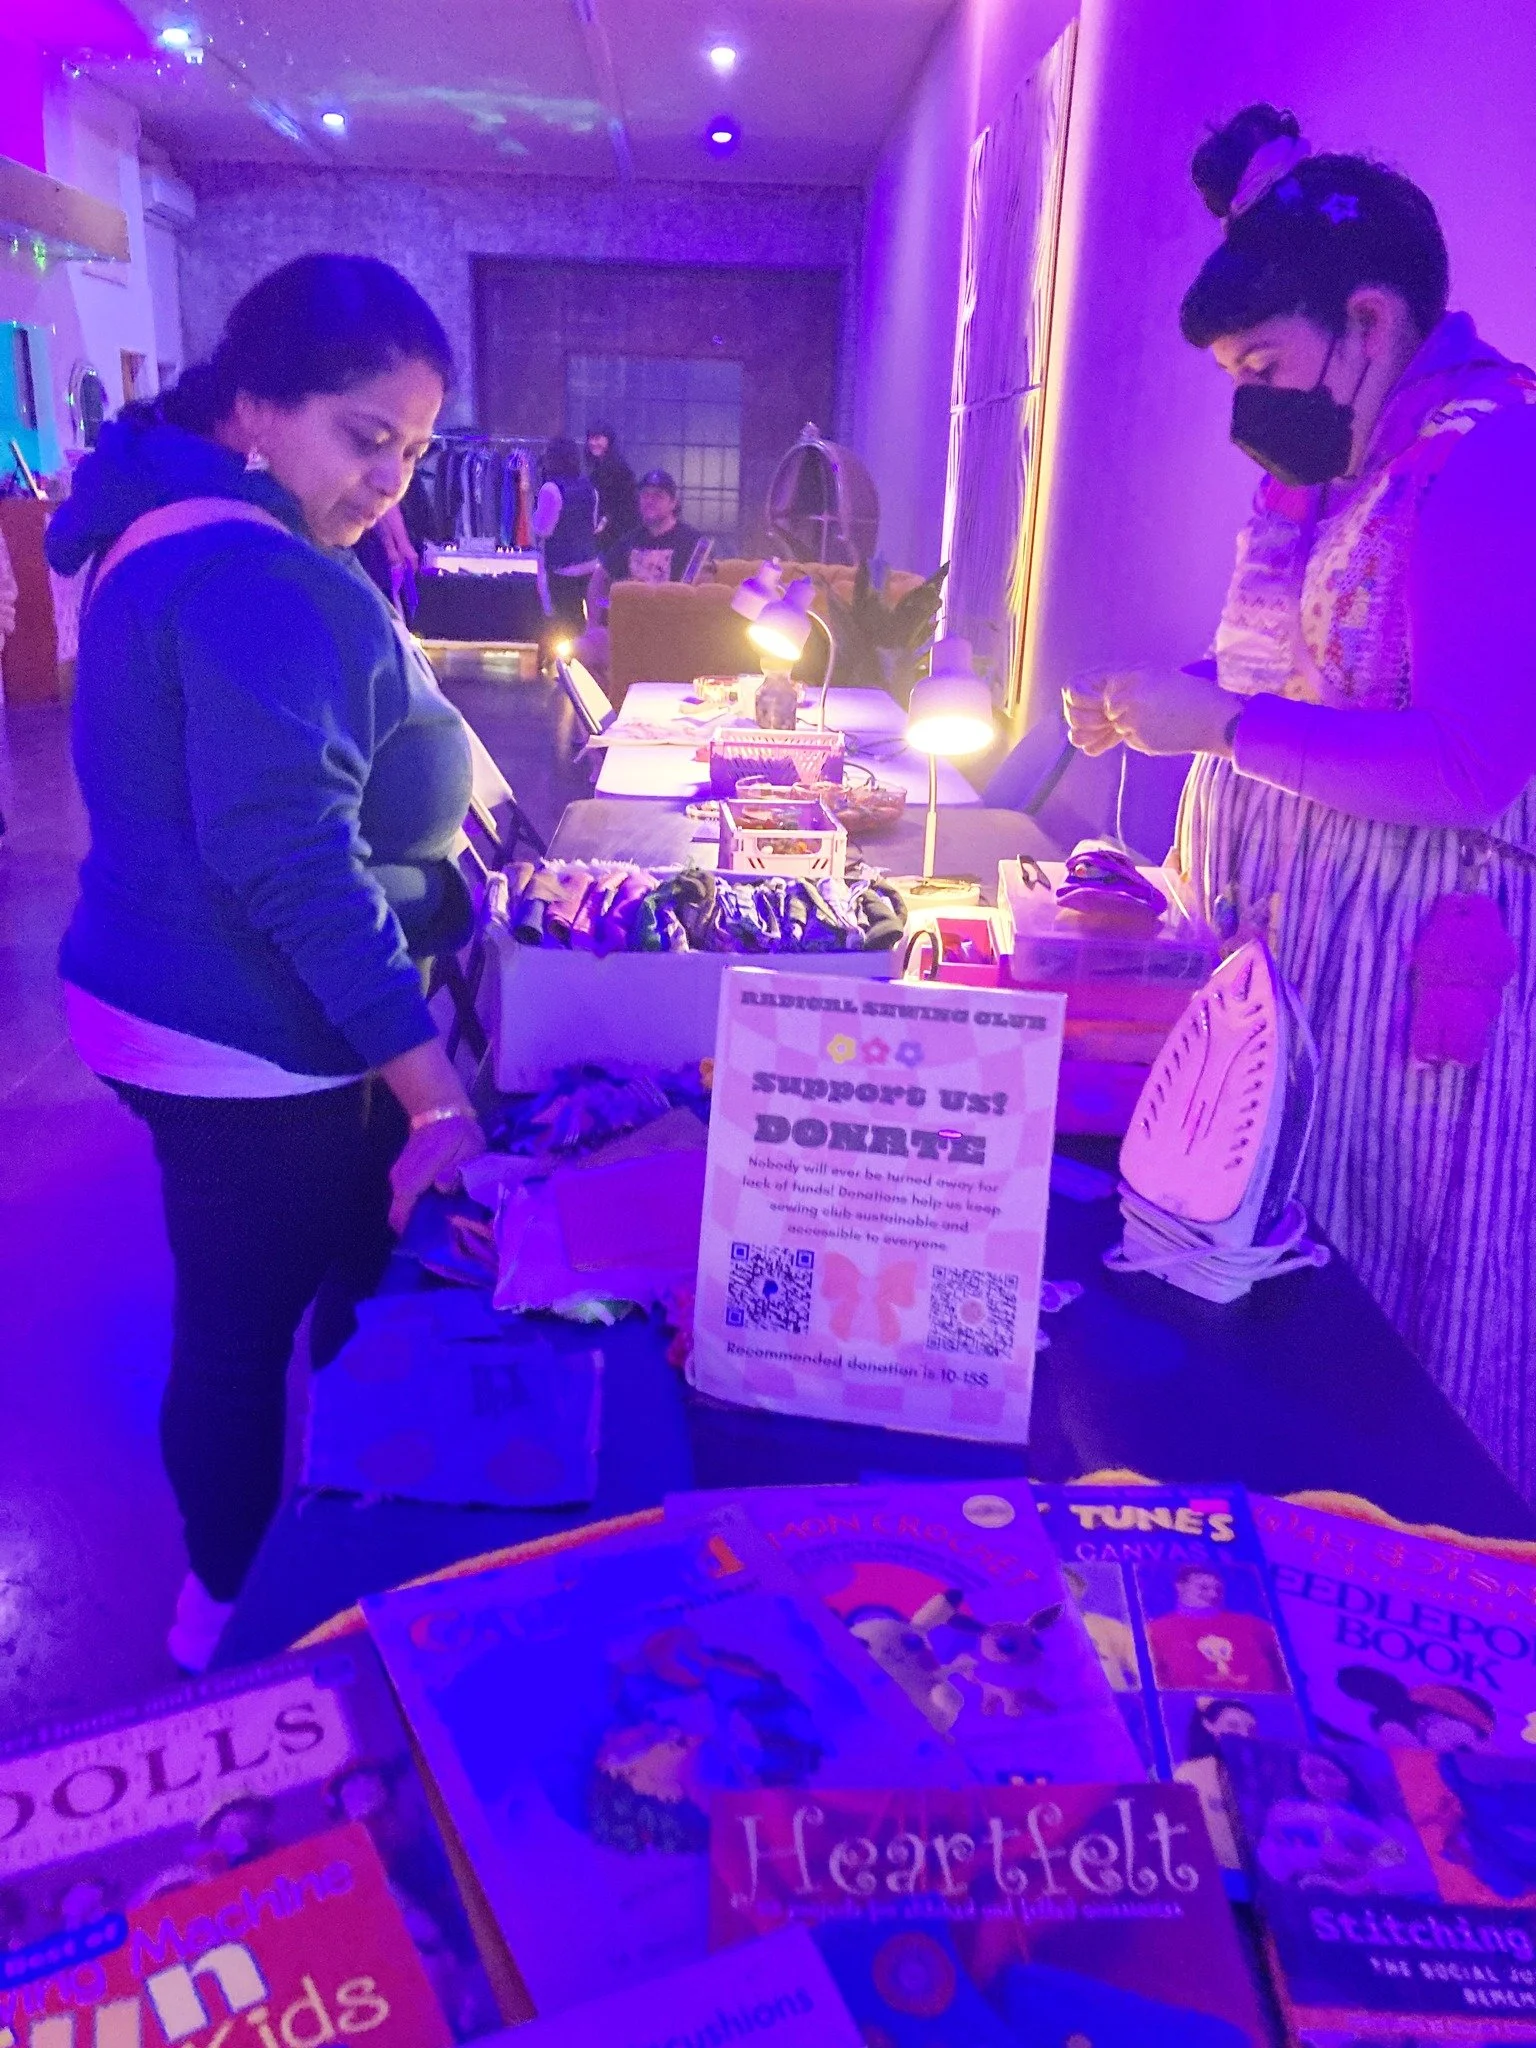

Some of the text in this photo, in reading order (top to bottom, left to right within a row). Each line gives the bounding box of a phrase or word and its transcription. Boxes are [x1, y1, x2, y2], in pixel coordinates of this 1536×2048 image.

[742, 990, 1047, 1031] RADICAL SEWING CLUB
[754, 1112, 987, 1165] DONATE
[749, 1156, 1000, 1194] Nobody will ever be turned away for
[742, 1175, 1002, 1217] lack of funds! Donations help us keep
[769, 1201, 970, 1233] sewing club sustainable and
[787, 1224, 948, 1251] accessible to everyone
[726, 1340, 844, 1369] Recommended
[847, 1355, 918, 1379] donation
[922, 1364, 936, 1380] is
[1068, 1503, 1237, 1543] TUNES
[1267, 1561, 1536, 1662] EEDLEPO
[1337, 1611, 1503, 1692] BOOK
[730, 1799, 1200, 1909] Heartfelt
[130, 1862, 354, 1979] Machine
[1308, 1906, 1534, 1964] Stitching
[1369, 1956, 1413, 1979] THE
[1418, 1961, 1500, 1984] SOCIAL
